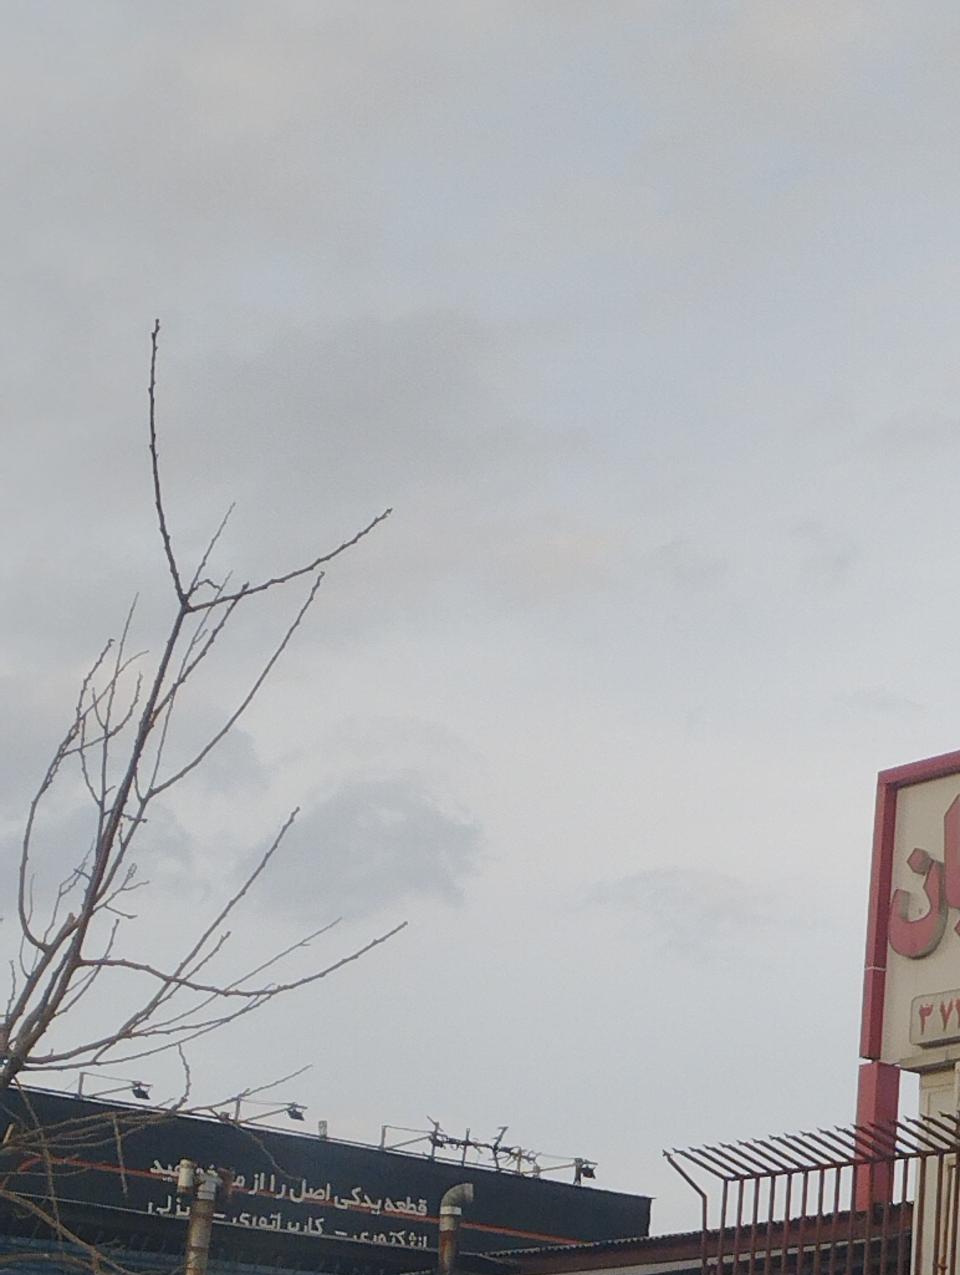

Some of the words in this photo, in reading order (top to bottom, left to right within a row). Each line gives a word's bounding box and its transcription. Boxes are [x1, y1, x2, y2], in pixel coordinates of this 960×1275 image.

[248, 1171, 266, 1196] از
[271, 1173, 287, 1200] را
[289, 1178, 331, 1203] اصل
[334, 1186, 383, 1216] یدکی
[383, 1195, 429, 1218] قطعه
